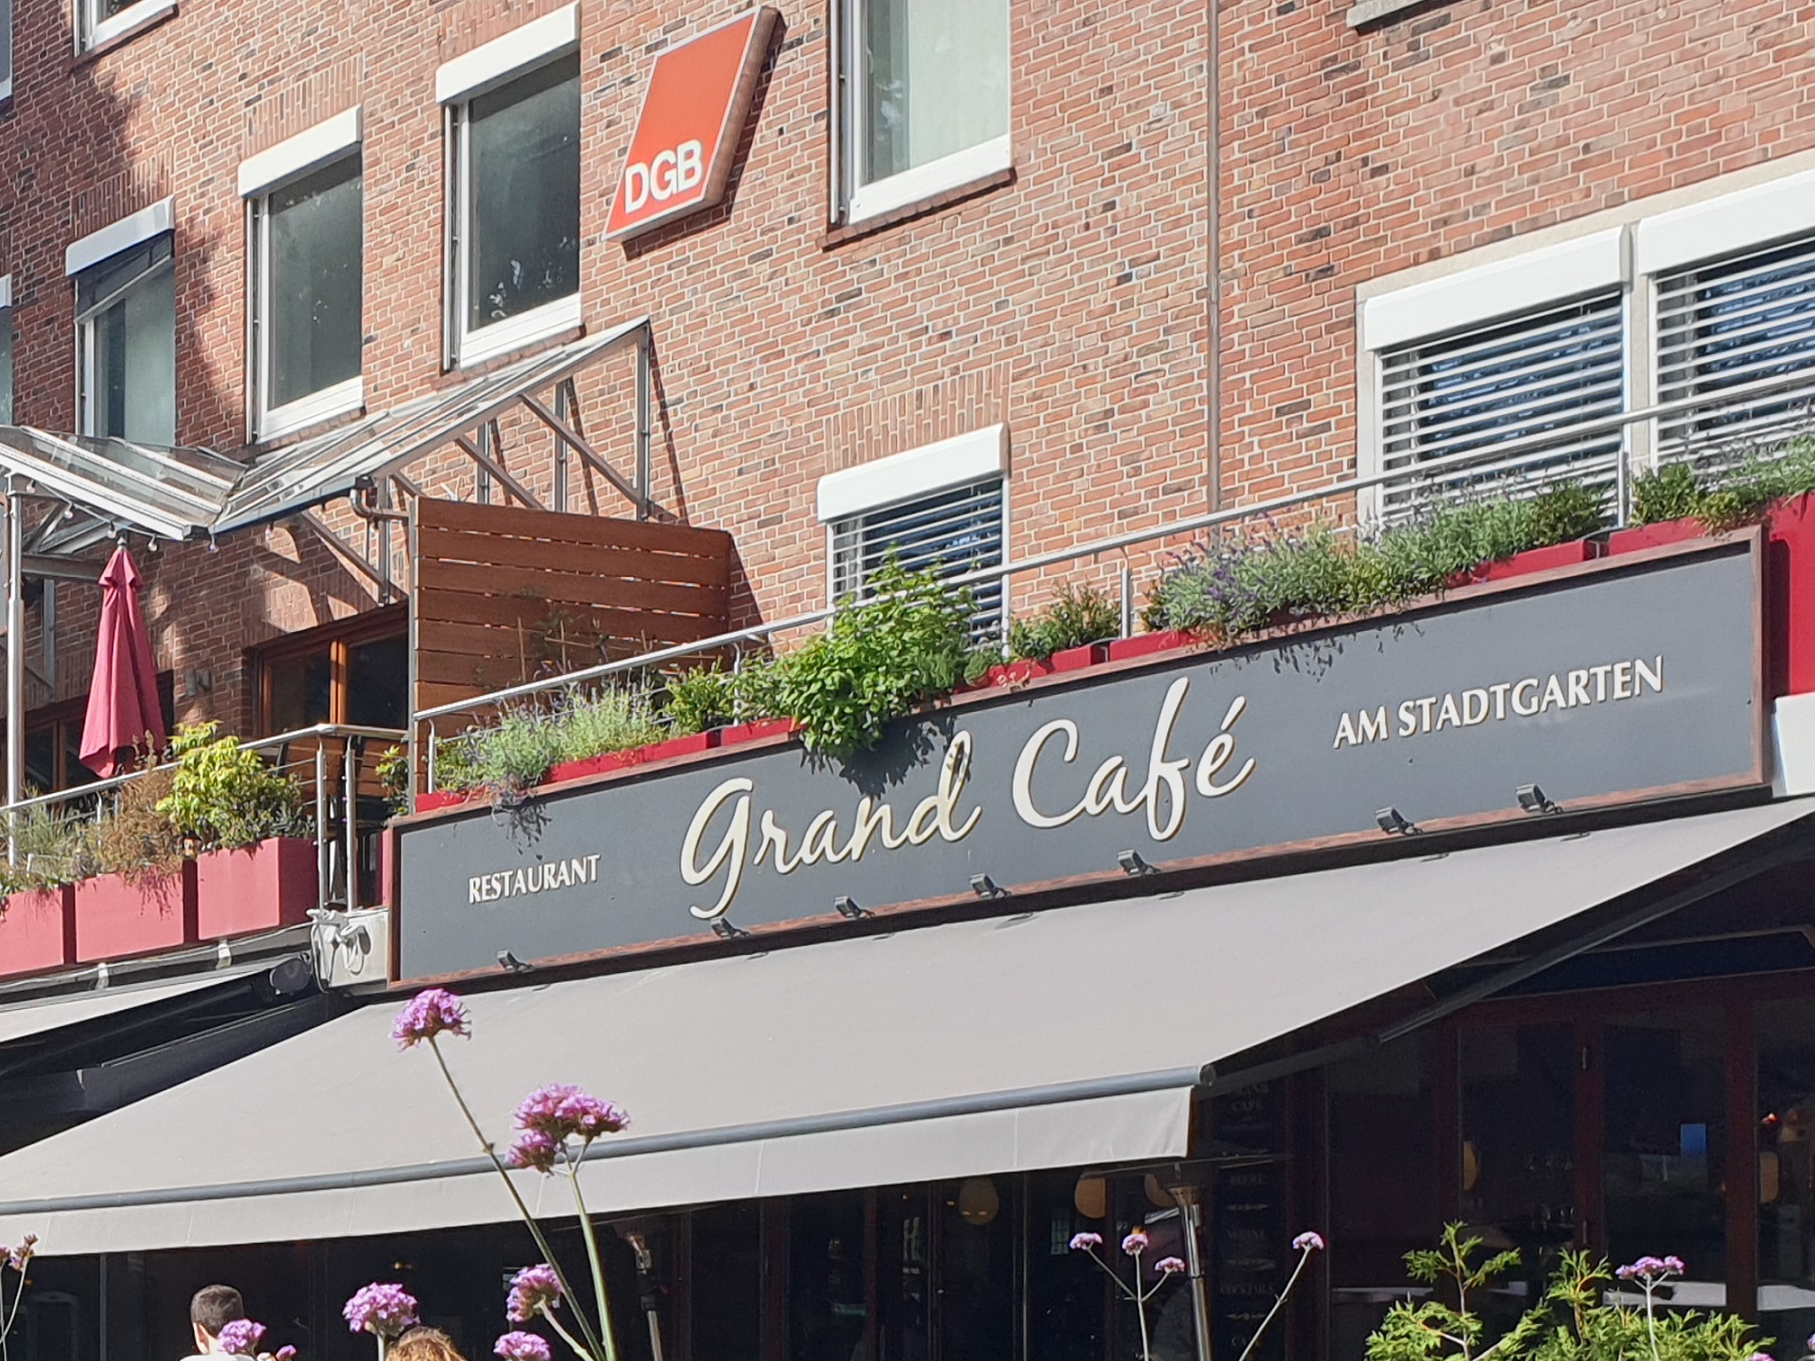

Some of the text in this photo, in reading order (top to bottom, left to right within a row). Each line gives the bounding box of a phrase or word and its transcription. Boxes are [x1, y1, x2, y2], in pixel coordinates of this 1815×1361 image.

[625, 139, 703, 214] DGB
[1332, 653, 1664, 749] AM STADTGARTEN
[680, 676, 1256, 919] Grand Café
[468, 853, 601, 905] RESTAURANT
